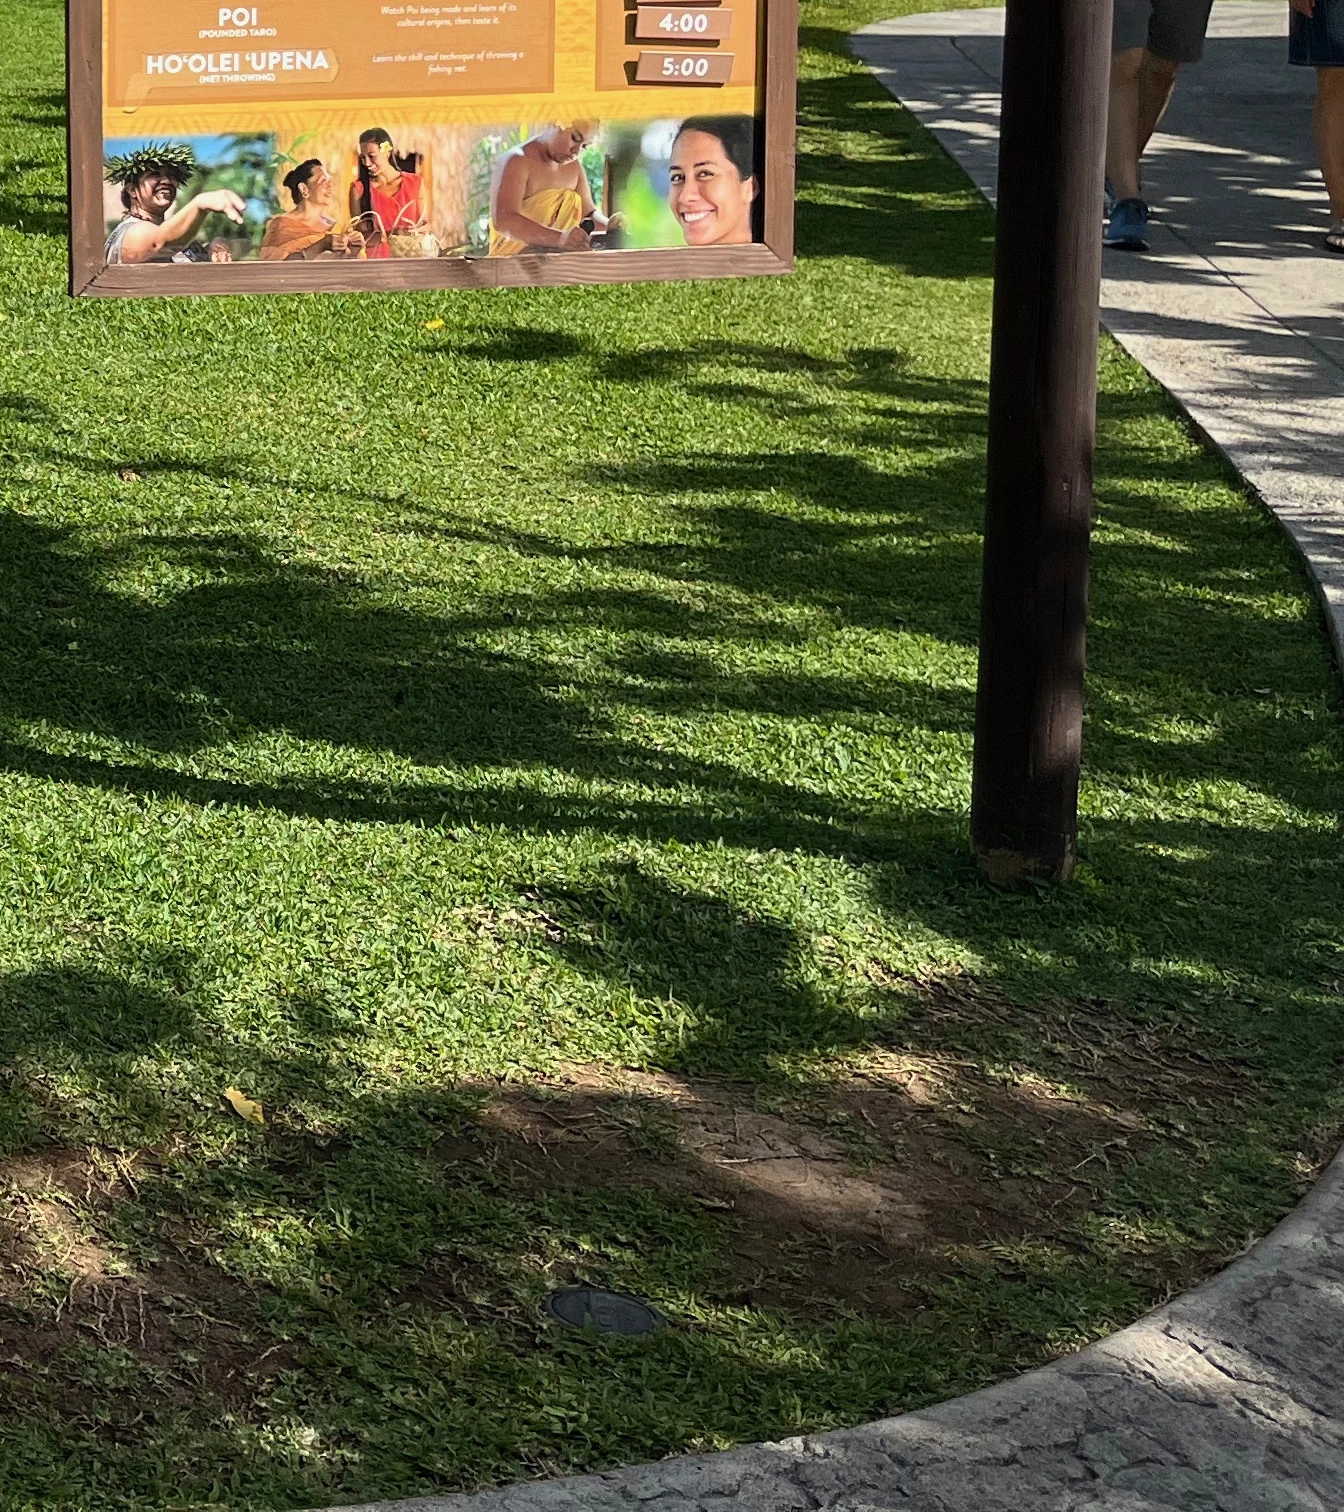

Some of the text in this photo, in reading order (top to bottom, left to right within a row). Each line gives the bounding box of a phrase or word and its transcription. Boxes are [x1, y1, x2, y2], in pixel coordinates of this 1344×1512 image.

[218, 7, 258, 27] POI
[658, 13, 708, 33] 4:00
[661, 57, 709, 77] 5:00
